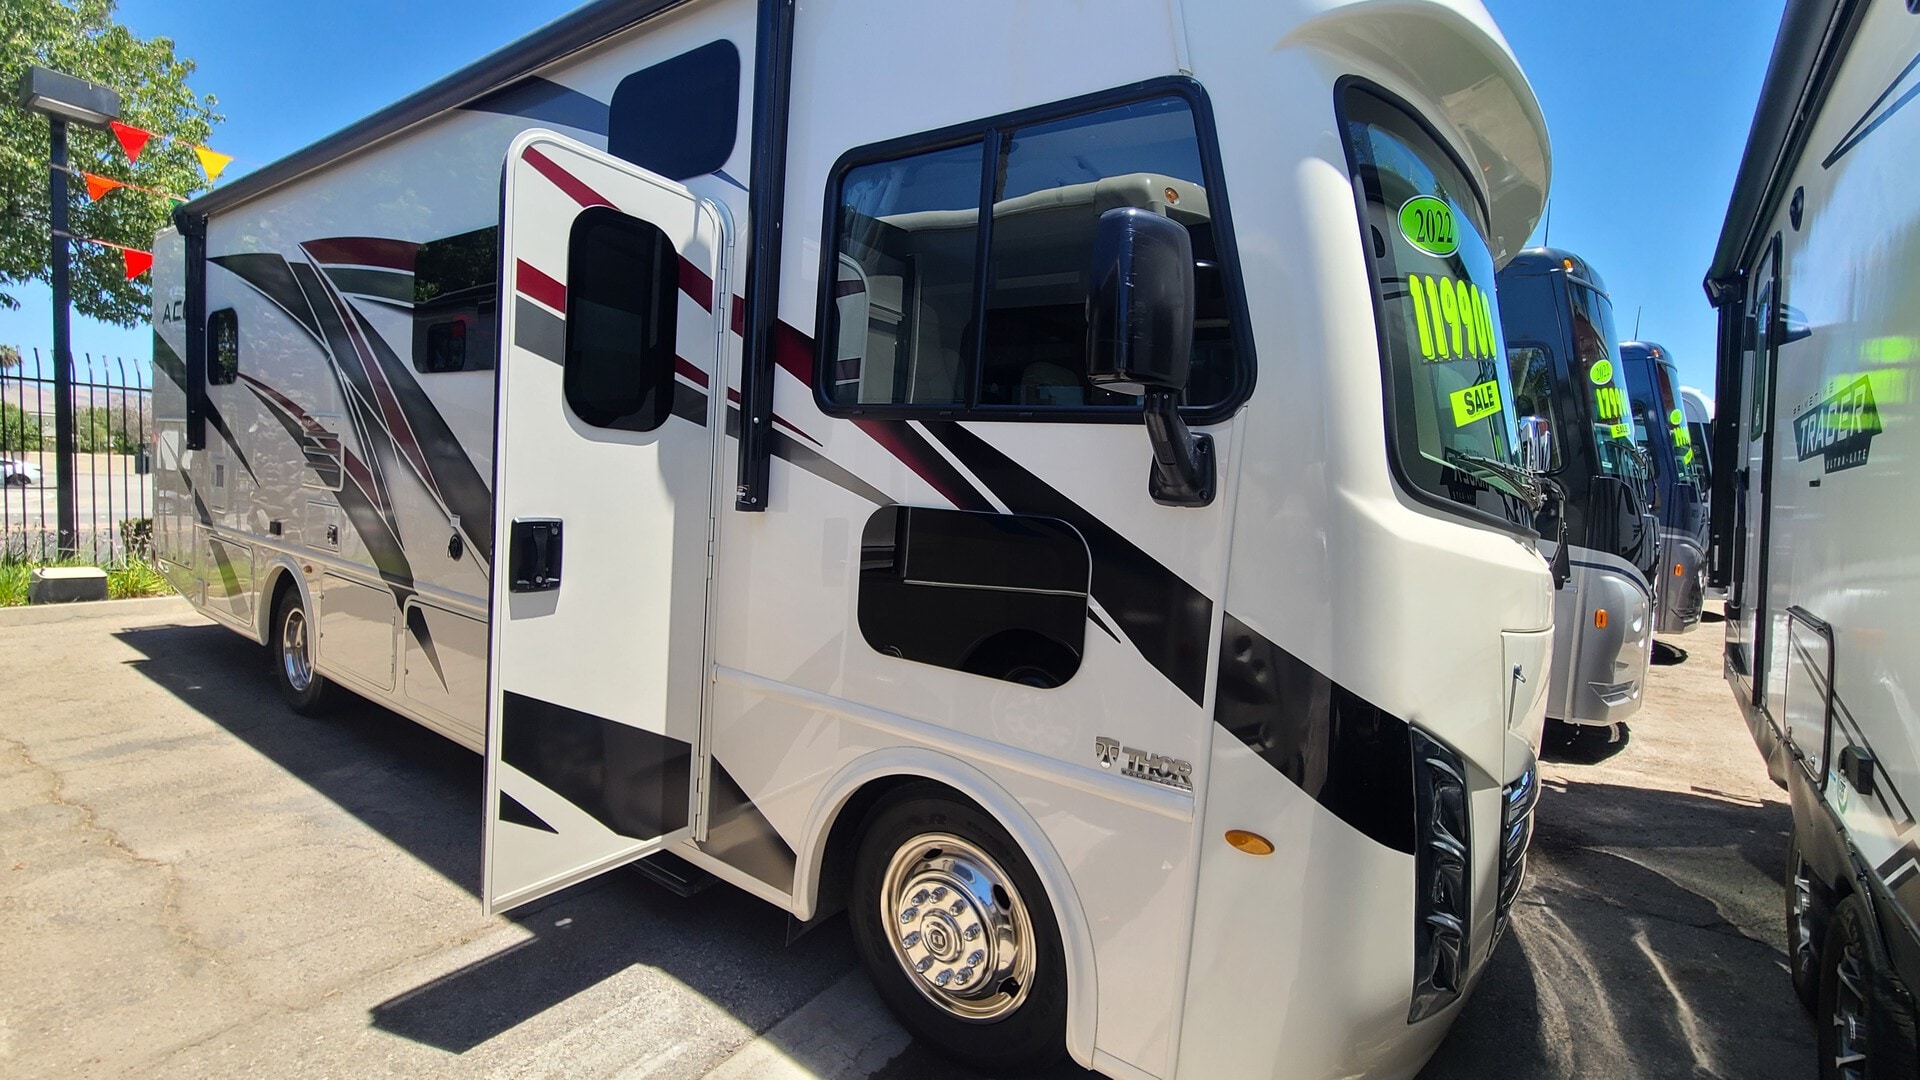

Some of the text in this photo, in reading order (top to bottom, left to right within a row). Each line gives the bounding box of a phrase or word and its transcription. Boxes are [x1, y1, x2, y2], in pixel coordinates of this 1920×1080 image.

[1415, 209, 1453, 244] 2022
[1464, 385, 1495, 416] SALE
[1800, 384, 1867, 456] TRACER
[1122, 746, 1193, 786] THOR
